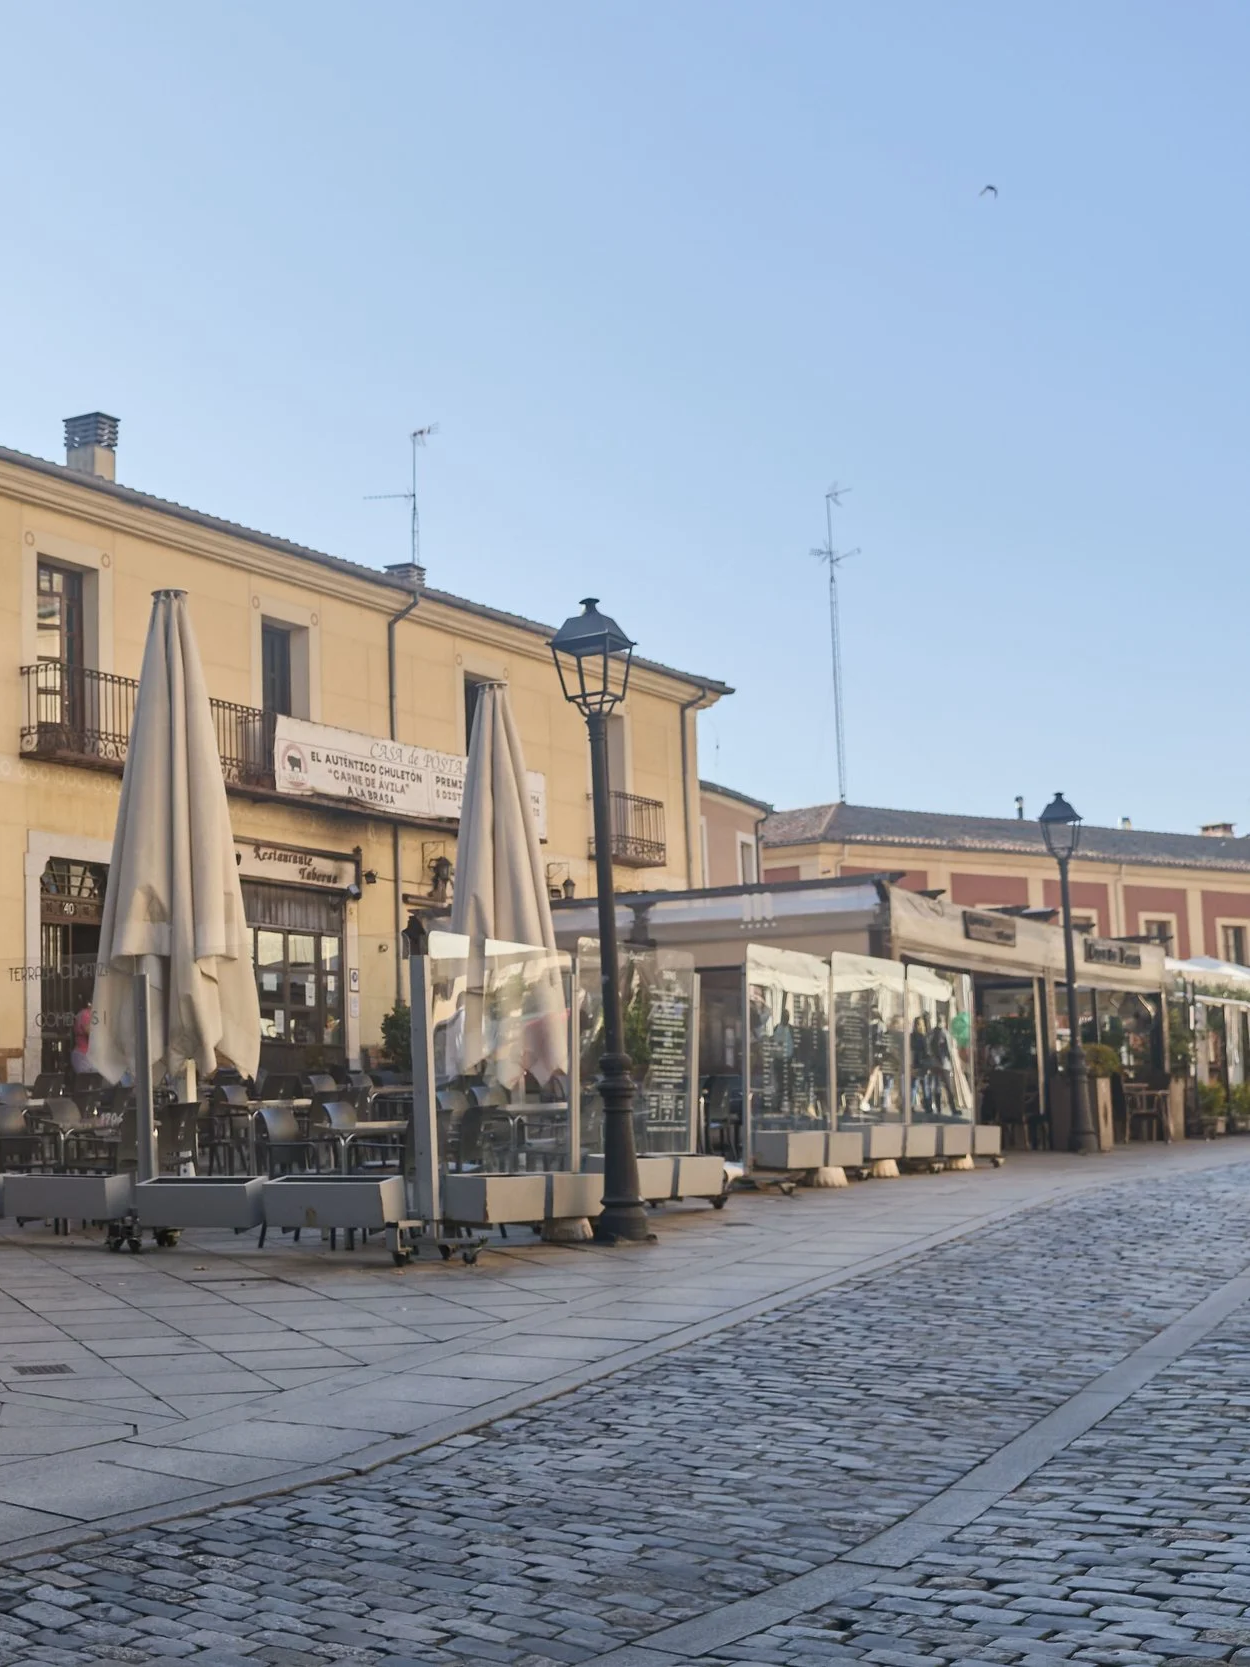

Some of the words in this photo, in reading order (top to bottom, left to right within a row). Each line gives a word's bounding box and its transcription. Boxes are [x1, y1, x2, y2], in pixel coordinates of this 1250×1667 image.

[370, 742, 403, 763] CASA
[408, 746, 419, 766] de
[311, 751, 322, 763] EL
[325, 754, 377, 774] AUTÉNTICO
[379, 765, 423, 783] CHULETÓN
[365, 777, 377, 789] DE
[347, 786, 355, 796] A
[356, 788, 366, 799] LA
[367, 791, 396, 805] BRASA
[253, 844, 313, 867] Restaurante
[298, 866, 338, 885] Taberna
[63, 902, 75, 915] 40
